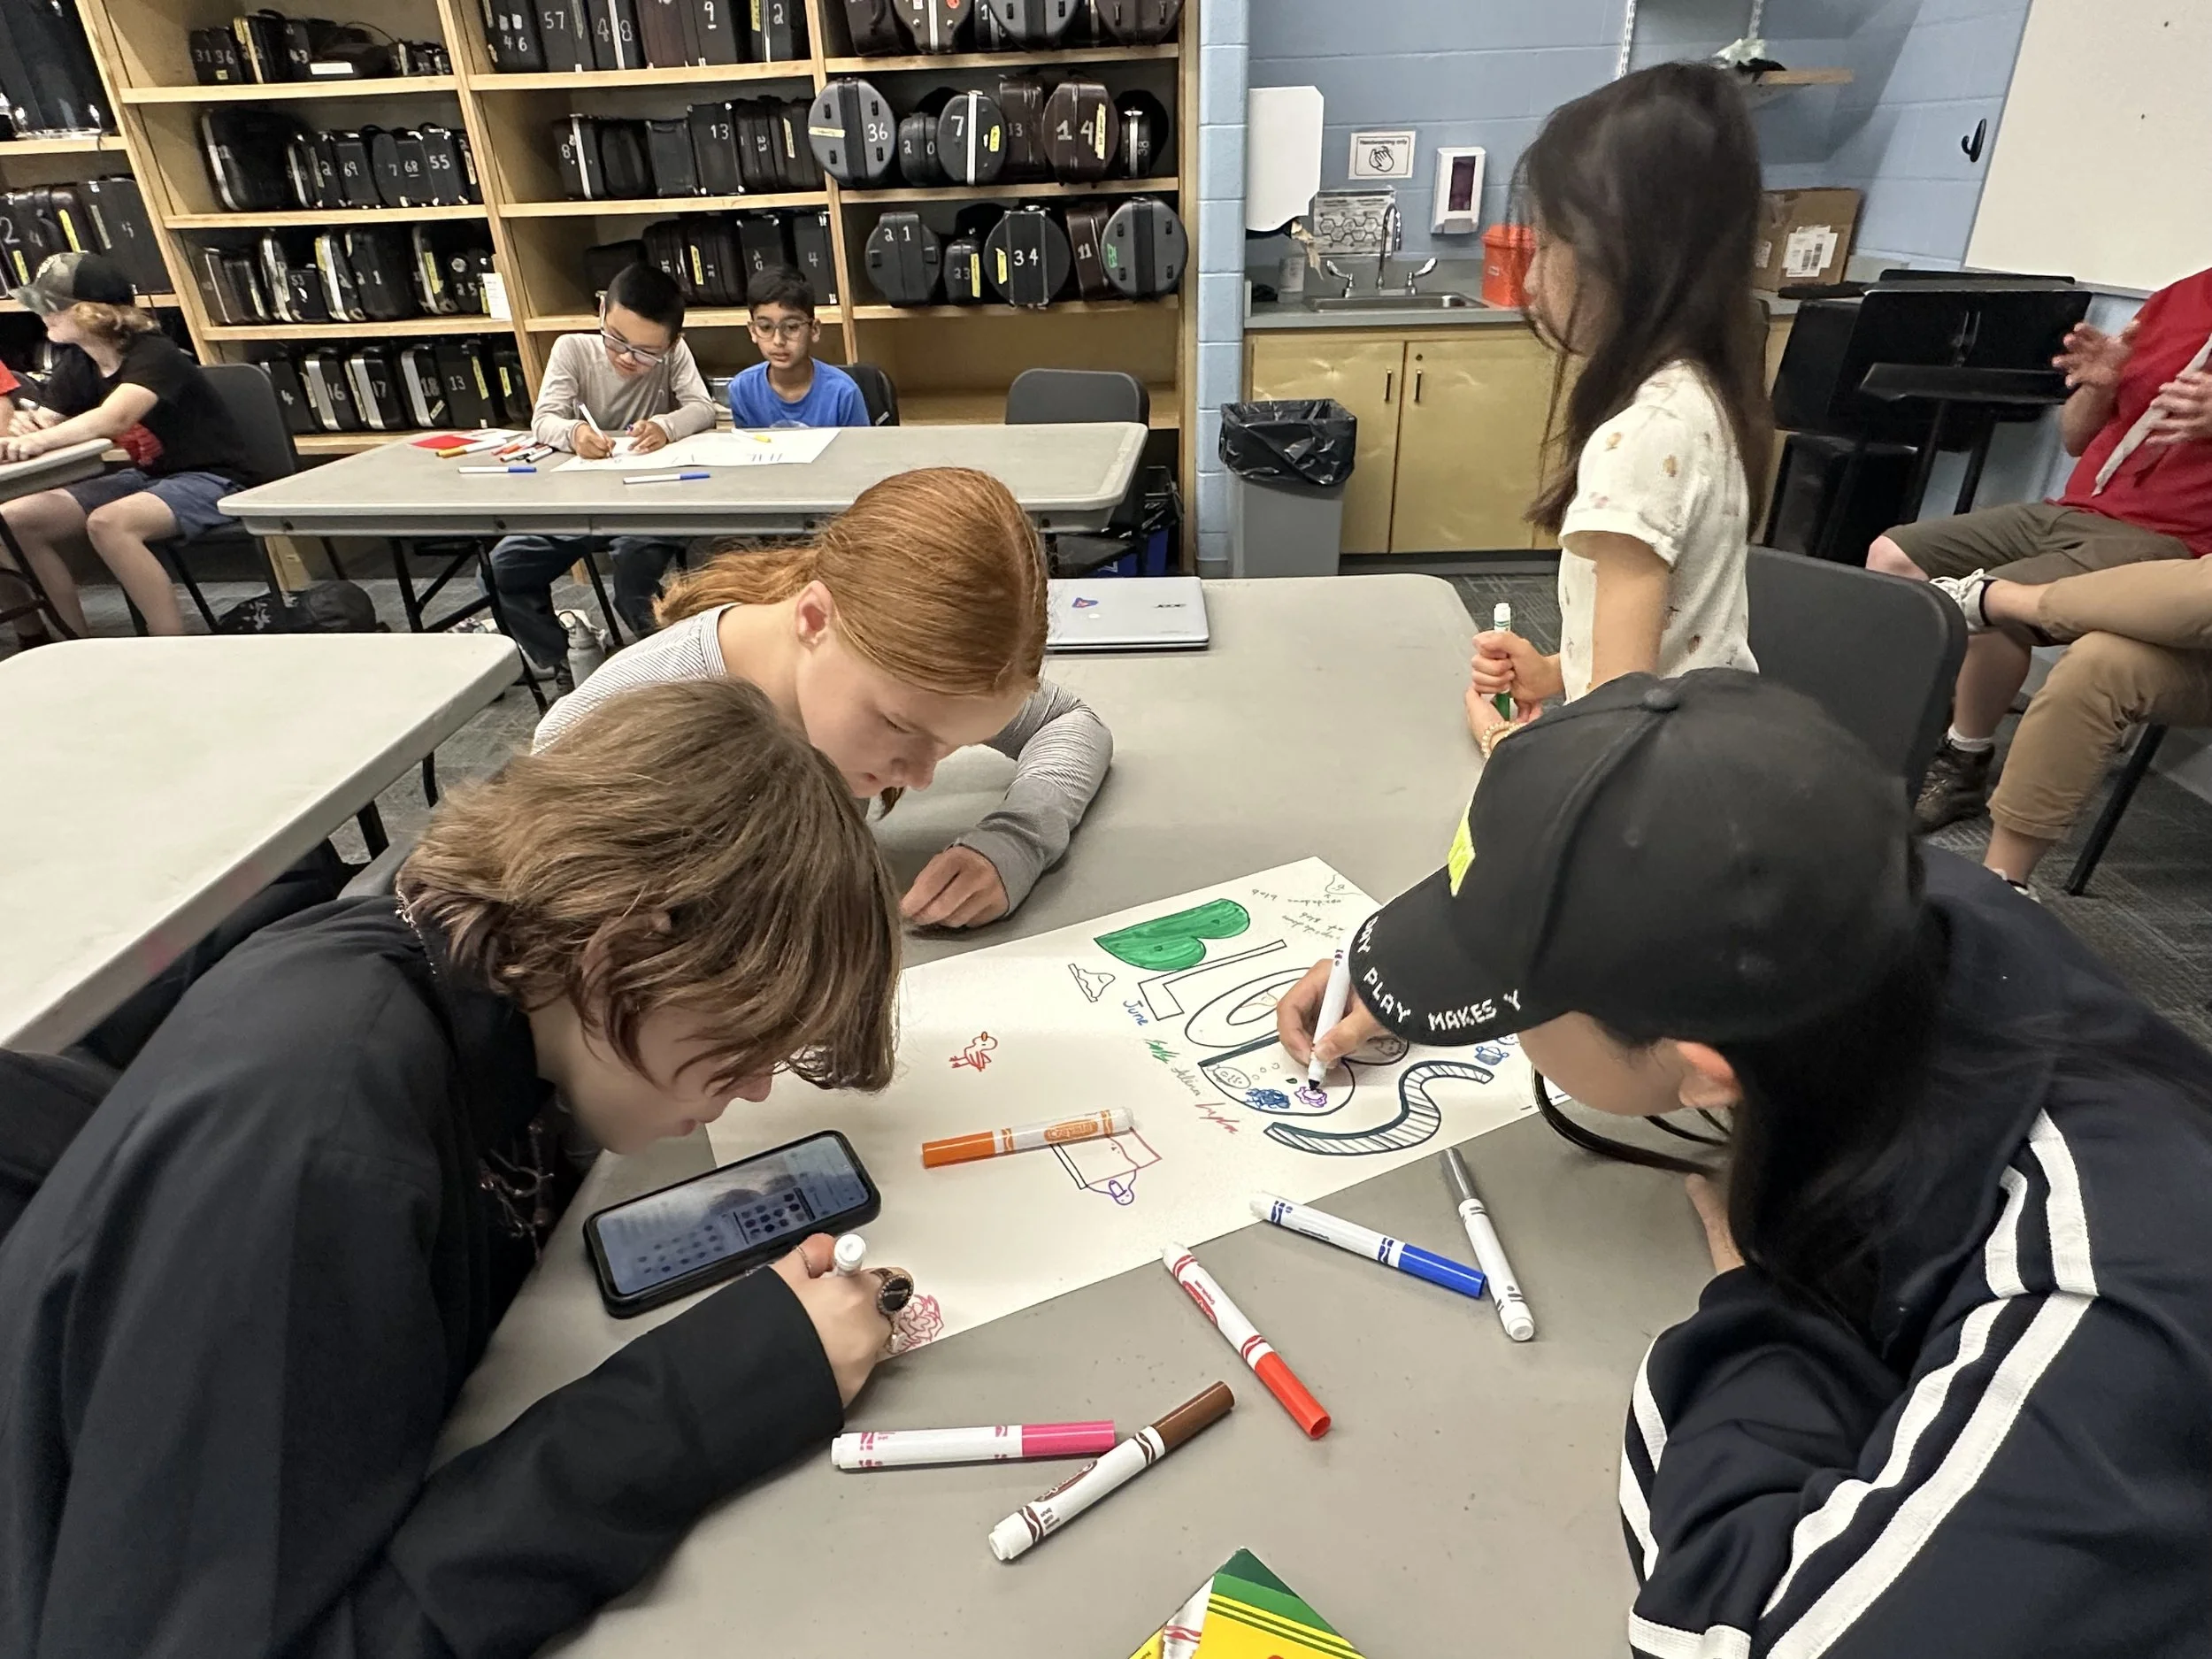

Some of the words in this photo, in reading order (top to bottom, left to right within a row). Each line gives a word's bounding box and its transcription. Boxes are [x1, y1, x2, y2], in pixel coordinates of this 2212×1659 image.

[545, 12, 565, 29] 57
[773, 4, 784, 25] 2
[710, 123, 729, 140] 13
[868, 122, 888, 142] 36
[951, 115, 964, 136] 7
[344, 161, 359, 177] 69
[404, 160, 419, 173] 68
[429, 154, 451, 170] 55
[449, 375, 466, 391] 13
[1363, 966, 1411, 1023] PLAY
[1427, 997, 1497, 1031] MAKES
[1123, 1000, 1148, 1025] June
